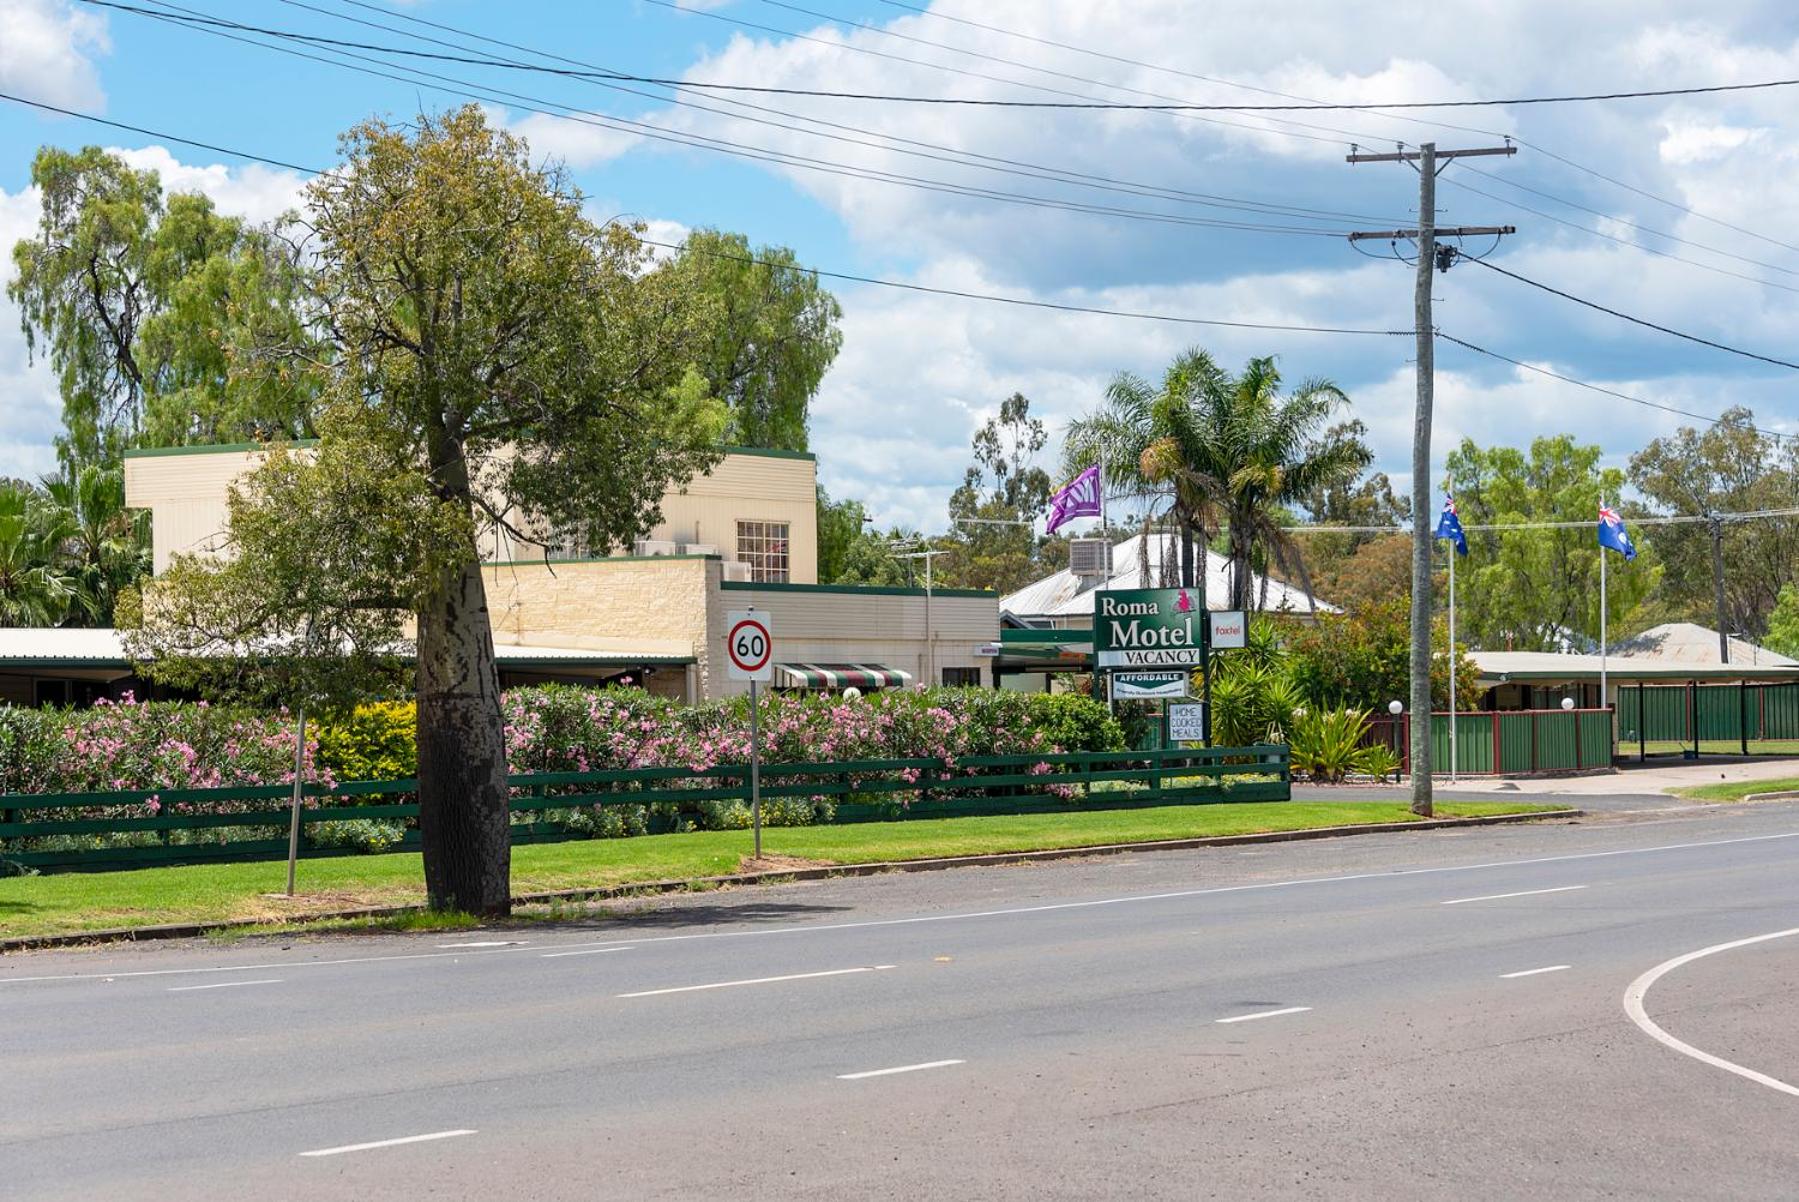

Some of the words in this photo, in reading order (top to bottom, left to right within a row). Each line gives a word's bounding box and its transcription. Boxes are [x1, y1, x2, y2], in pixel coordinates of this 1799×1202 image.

[1102, 597, 1159, 616] Roma
[1110, 618, 1194, 648] Motel
[1215, 626, 1241, 635] foxtel
[737, 635, 764, 657] 60
[1125, 650, 1197, 664] VACANCY
[1175, 707, 1197, 717] HOME
[1171, 717, 1202, 727] COOKED
[1172, 728, 1200, 737] MEALS
